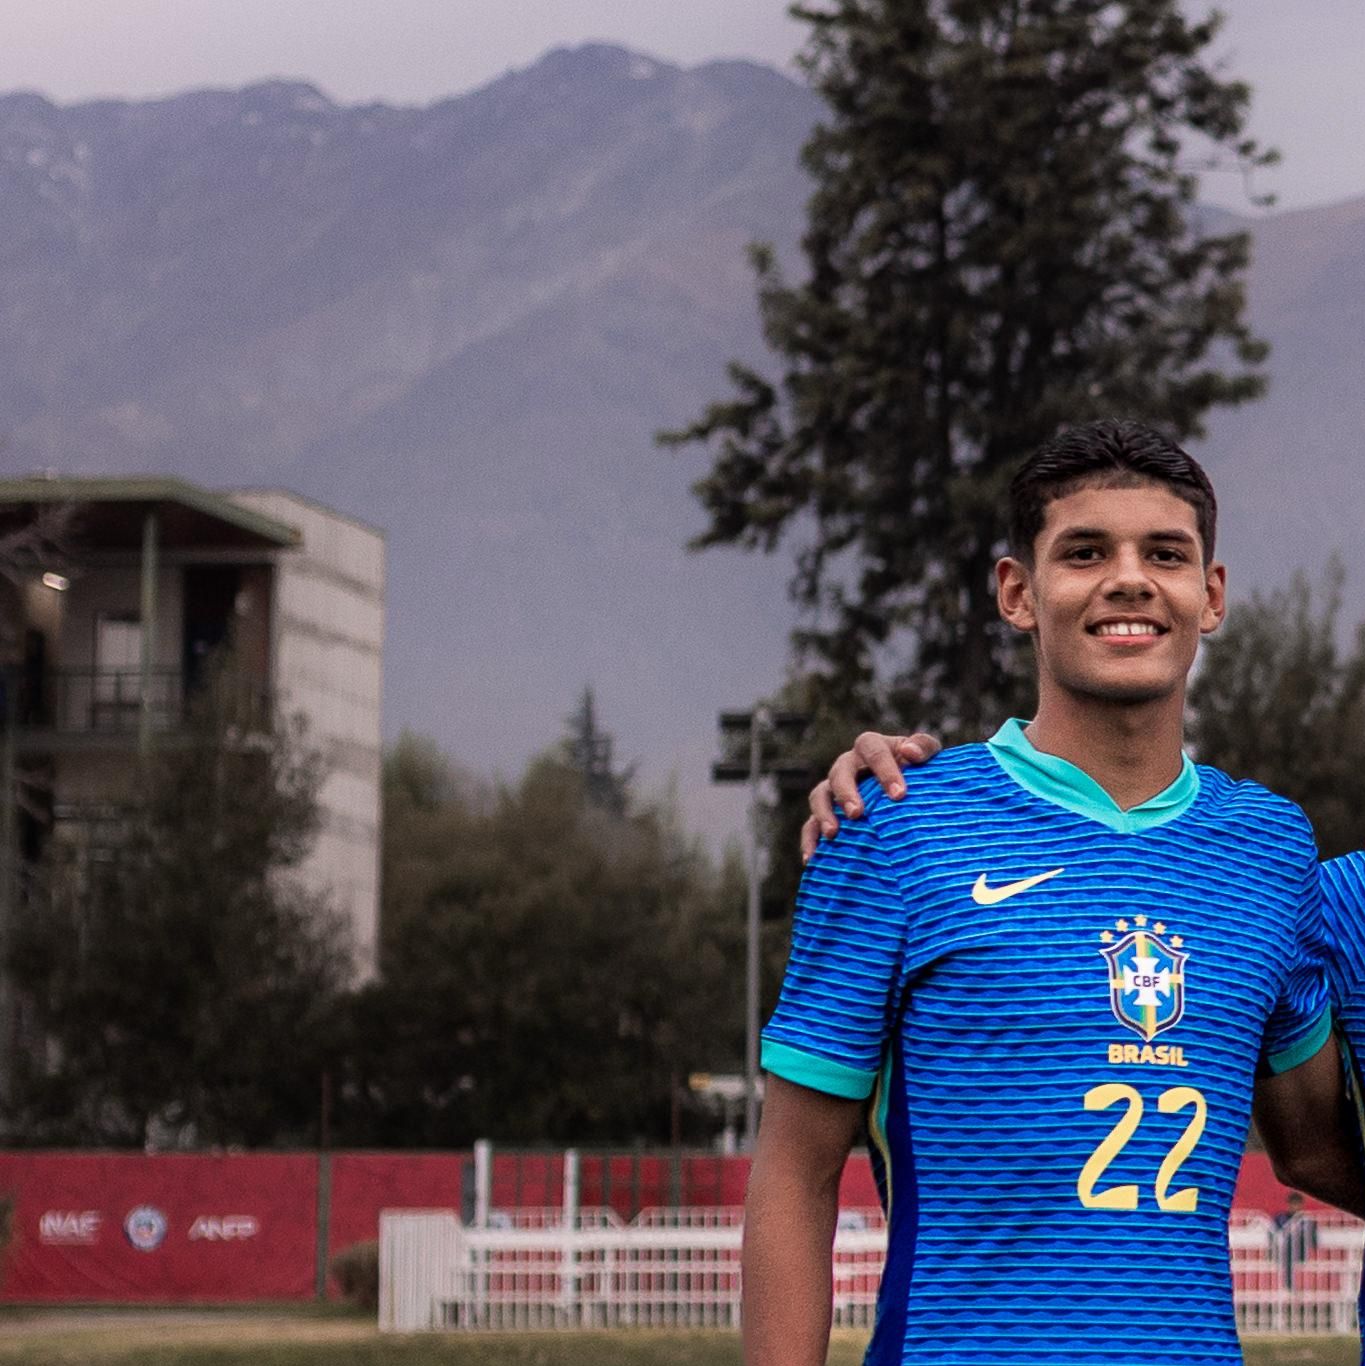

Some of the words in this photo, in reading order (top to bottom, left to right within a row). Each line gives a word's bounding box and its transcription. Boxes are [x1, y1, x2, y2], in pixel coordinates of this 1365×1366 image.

[1133, 975, 1160, 988] CBF
[1108, 1044, 1188, 1066] BRASIL
[1077, 1083, 1207, 1212] 22
